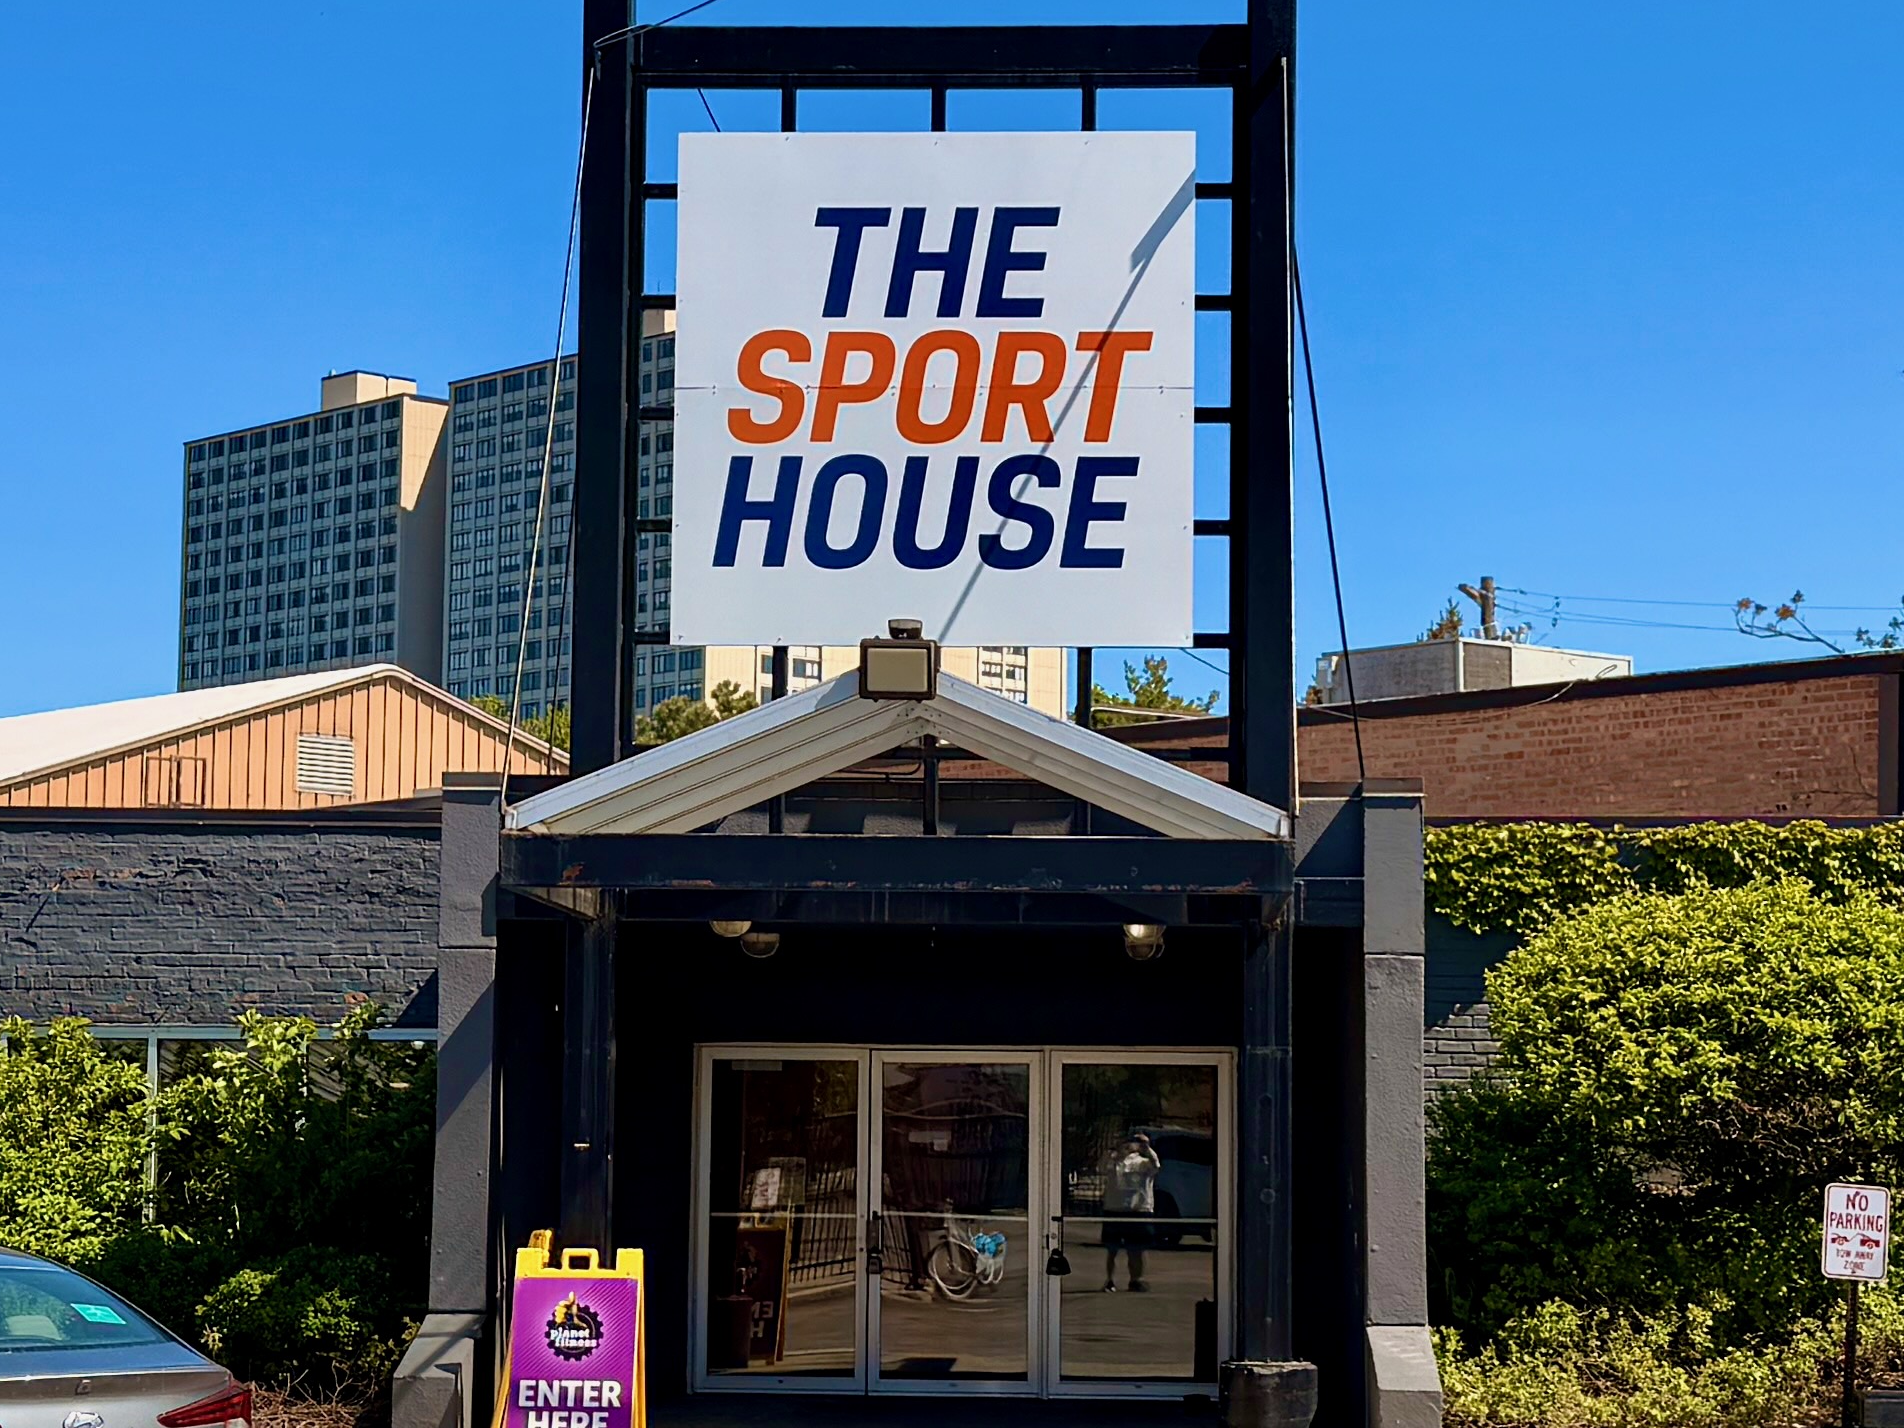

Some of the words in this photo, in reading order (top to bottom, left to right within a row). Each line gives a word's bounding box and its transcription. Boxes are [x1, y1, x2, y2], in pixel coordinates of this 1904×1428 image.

[814, 206, 1061, 318] THE
[727, 329, 1153, 444] SPORT
[712, 453, 1140, 570] HOUSE
[1846, 1194, 1869, 1212] NO
[1829, 1211, 1883, 1233] PARKING
[550, 1326, 590, 1341] planet
[518, 1379, 622, 1408] ENTER
